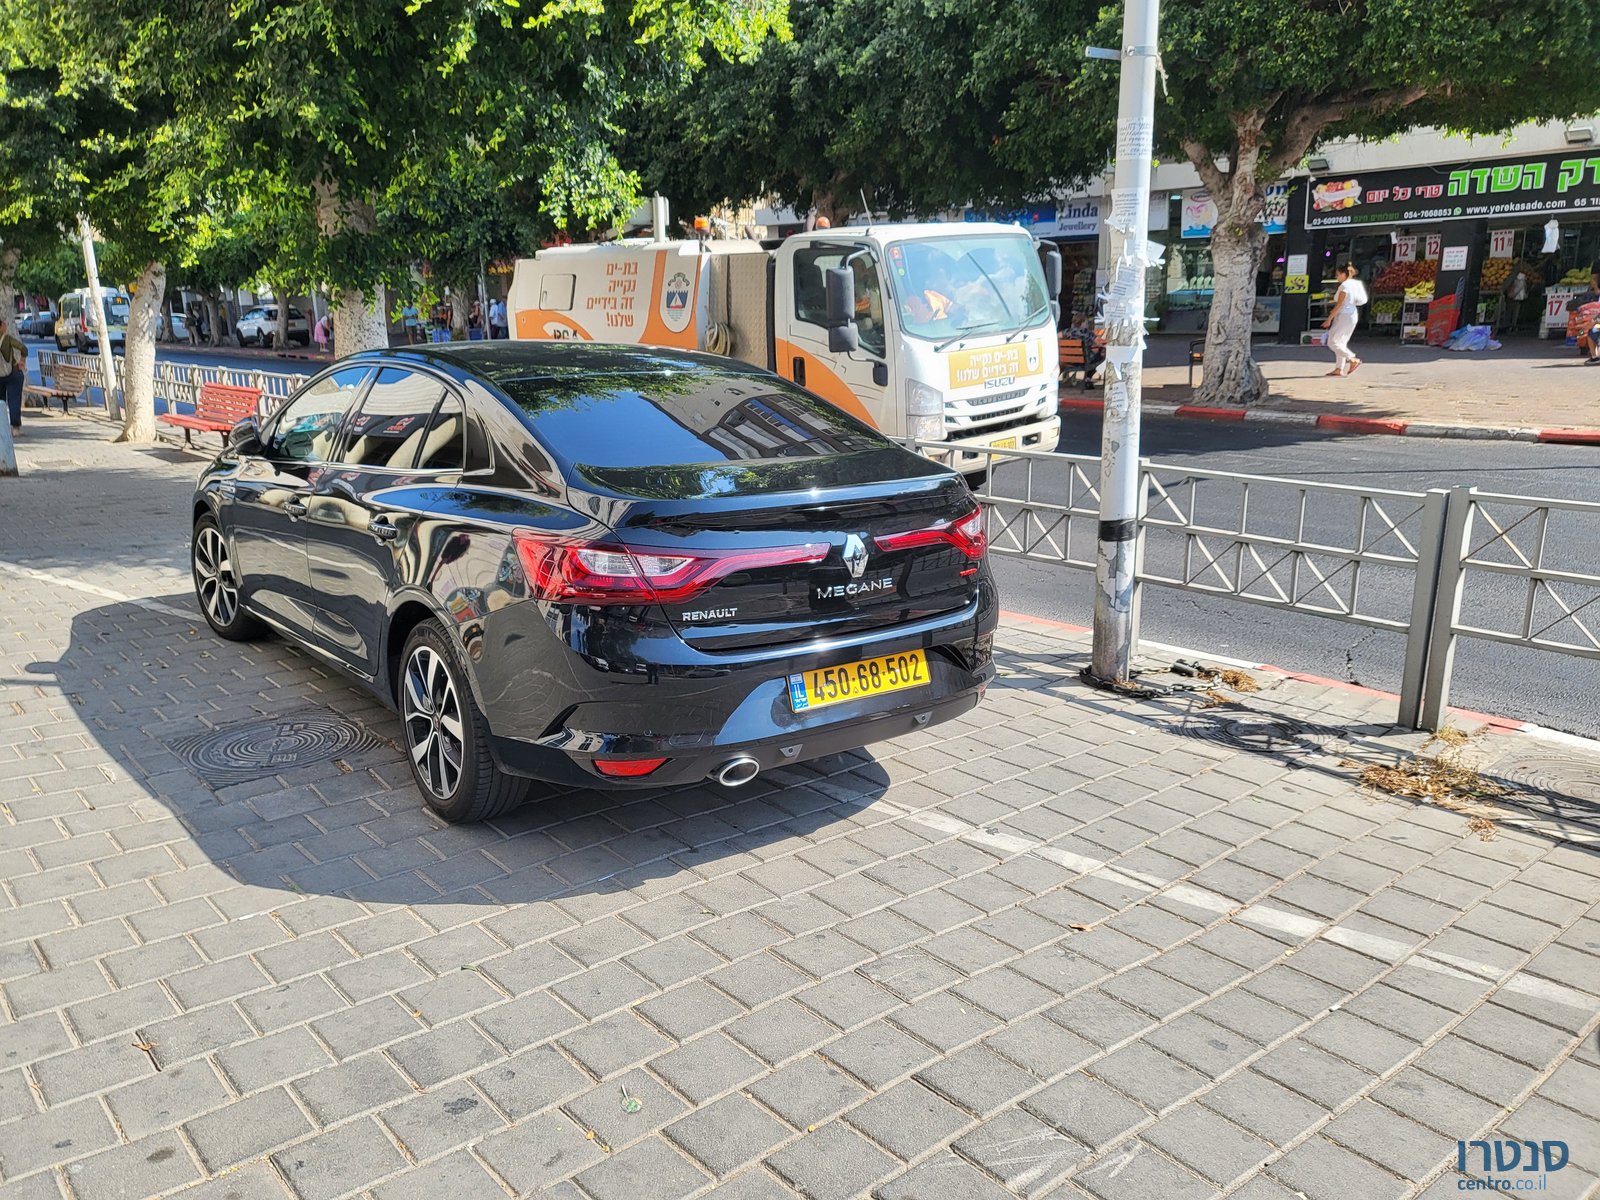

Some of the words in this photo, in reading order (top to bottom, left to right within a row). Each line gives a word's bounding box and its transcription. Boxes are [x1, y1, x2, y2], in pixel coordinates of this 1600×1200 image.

[1447, 162, 1547, 197] השדה
[1366, 189, 1389, 203] יום
[1392, 186, 1412, 201] כל
[1415, 184, 1443, 198] טרי
[1397, 242, 1409, 257] 12
[1427, 241, 1439, 255] 12
[606, 262, 638, 275] בת-ים
[608, 279, 636, 295] נקייה
[586, 297, 617, 310] בידיים
[621, 297, 634, 309] זה
[1548, 300, 1562, 316] 17
[606, 312, 634, 327] שלנו!
[984, 376, 1015, 389] ISUZU
[816, 577, 893, 600] MEGANE
[681, 607, 738, 622] RENAULT
[793, 684, 805, 701] IL
